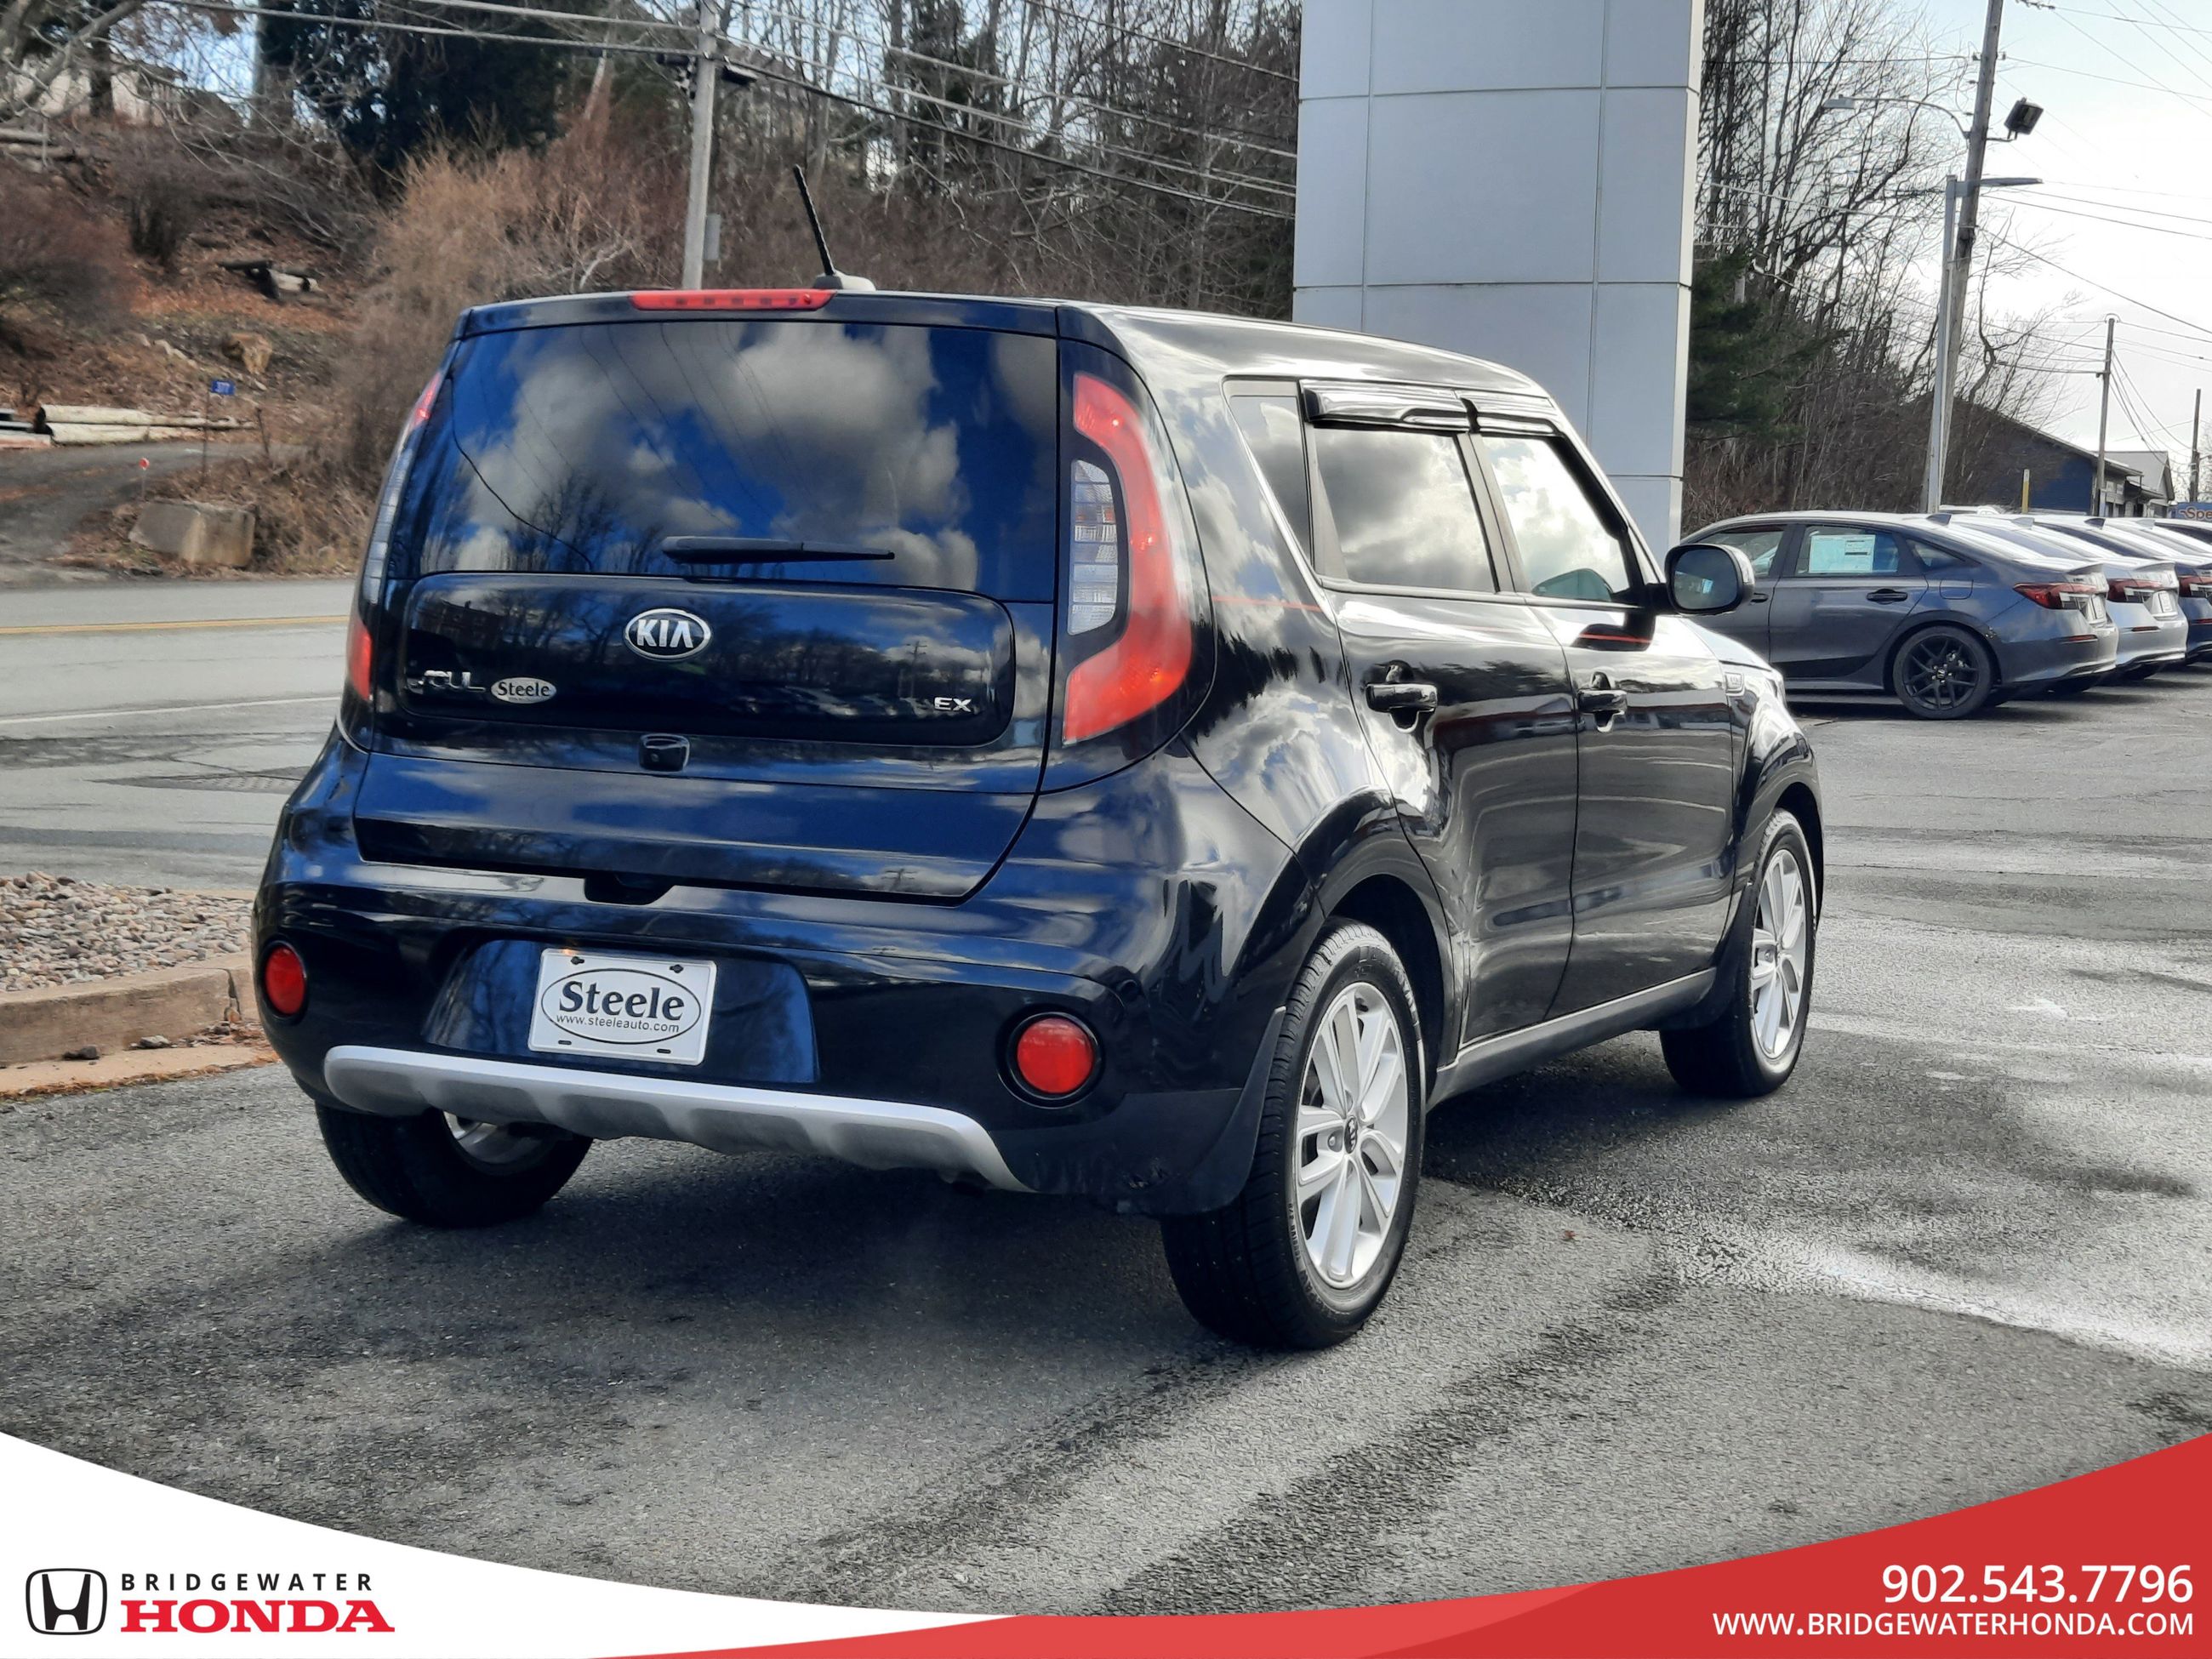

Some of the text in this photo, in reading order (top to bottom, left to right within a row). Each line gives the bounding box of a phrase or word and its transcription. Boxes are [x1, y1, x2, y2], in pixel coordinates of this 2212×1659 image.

[636, 619, 694, 648] KIA
[497, 681, 550, 697] Steele
[934, 696, 972, 712] EX
[559, 980, 685, 1021] Steele
[556, 1014, 679, 1033] www.steeleauto.com
